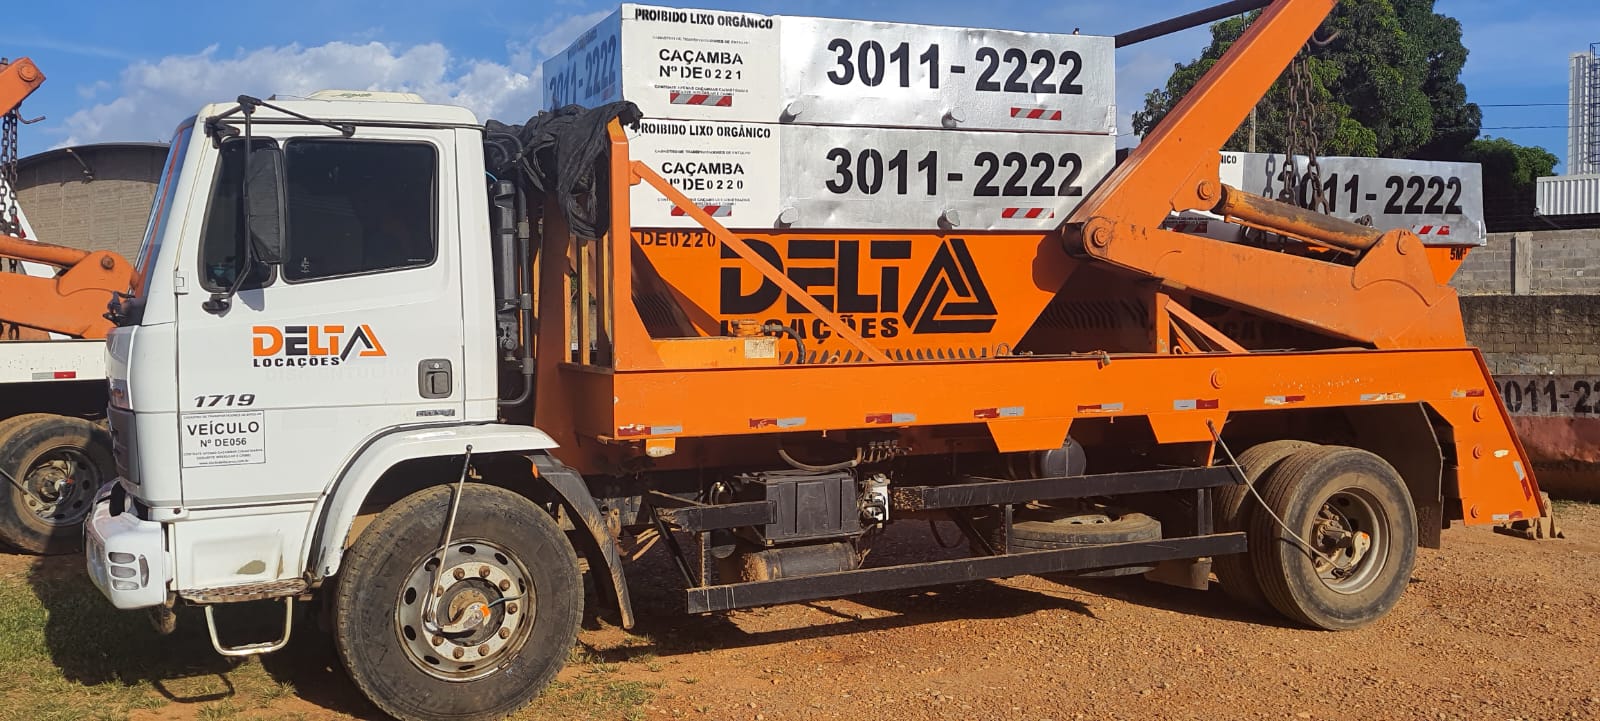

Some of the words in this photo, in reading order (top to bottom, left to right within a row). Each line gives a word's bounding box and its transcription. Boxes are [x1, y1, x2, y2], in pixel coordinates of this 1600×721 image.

[635, 8, 687, 23] PROIBIDO
[690, 13, 714, 26] LIXO
[718, 14, 773, 30] ORGÂNICO
[659, 48, 743, 65] CAÇAMBA
[827, 38, 1083, 95] 3011-2222
[689, 125, 713, 137] LIXO
[717, 124, 771, 139] ORGÂNICO
[662, 161, 744, 177] CAÇAMBA
[825, 147, 1083, 197] 3011-2222
[252, 324, 387, 362] DELTA
[253, 356, 340, 368] LOCAÇÕES
[194, 393, 255, 408] 1719
[187, 420, 259, 436] VEÍCULO
[215, 437, 247, 447] DE056
